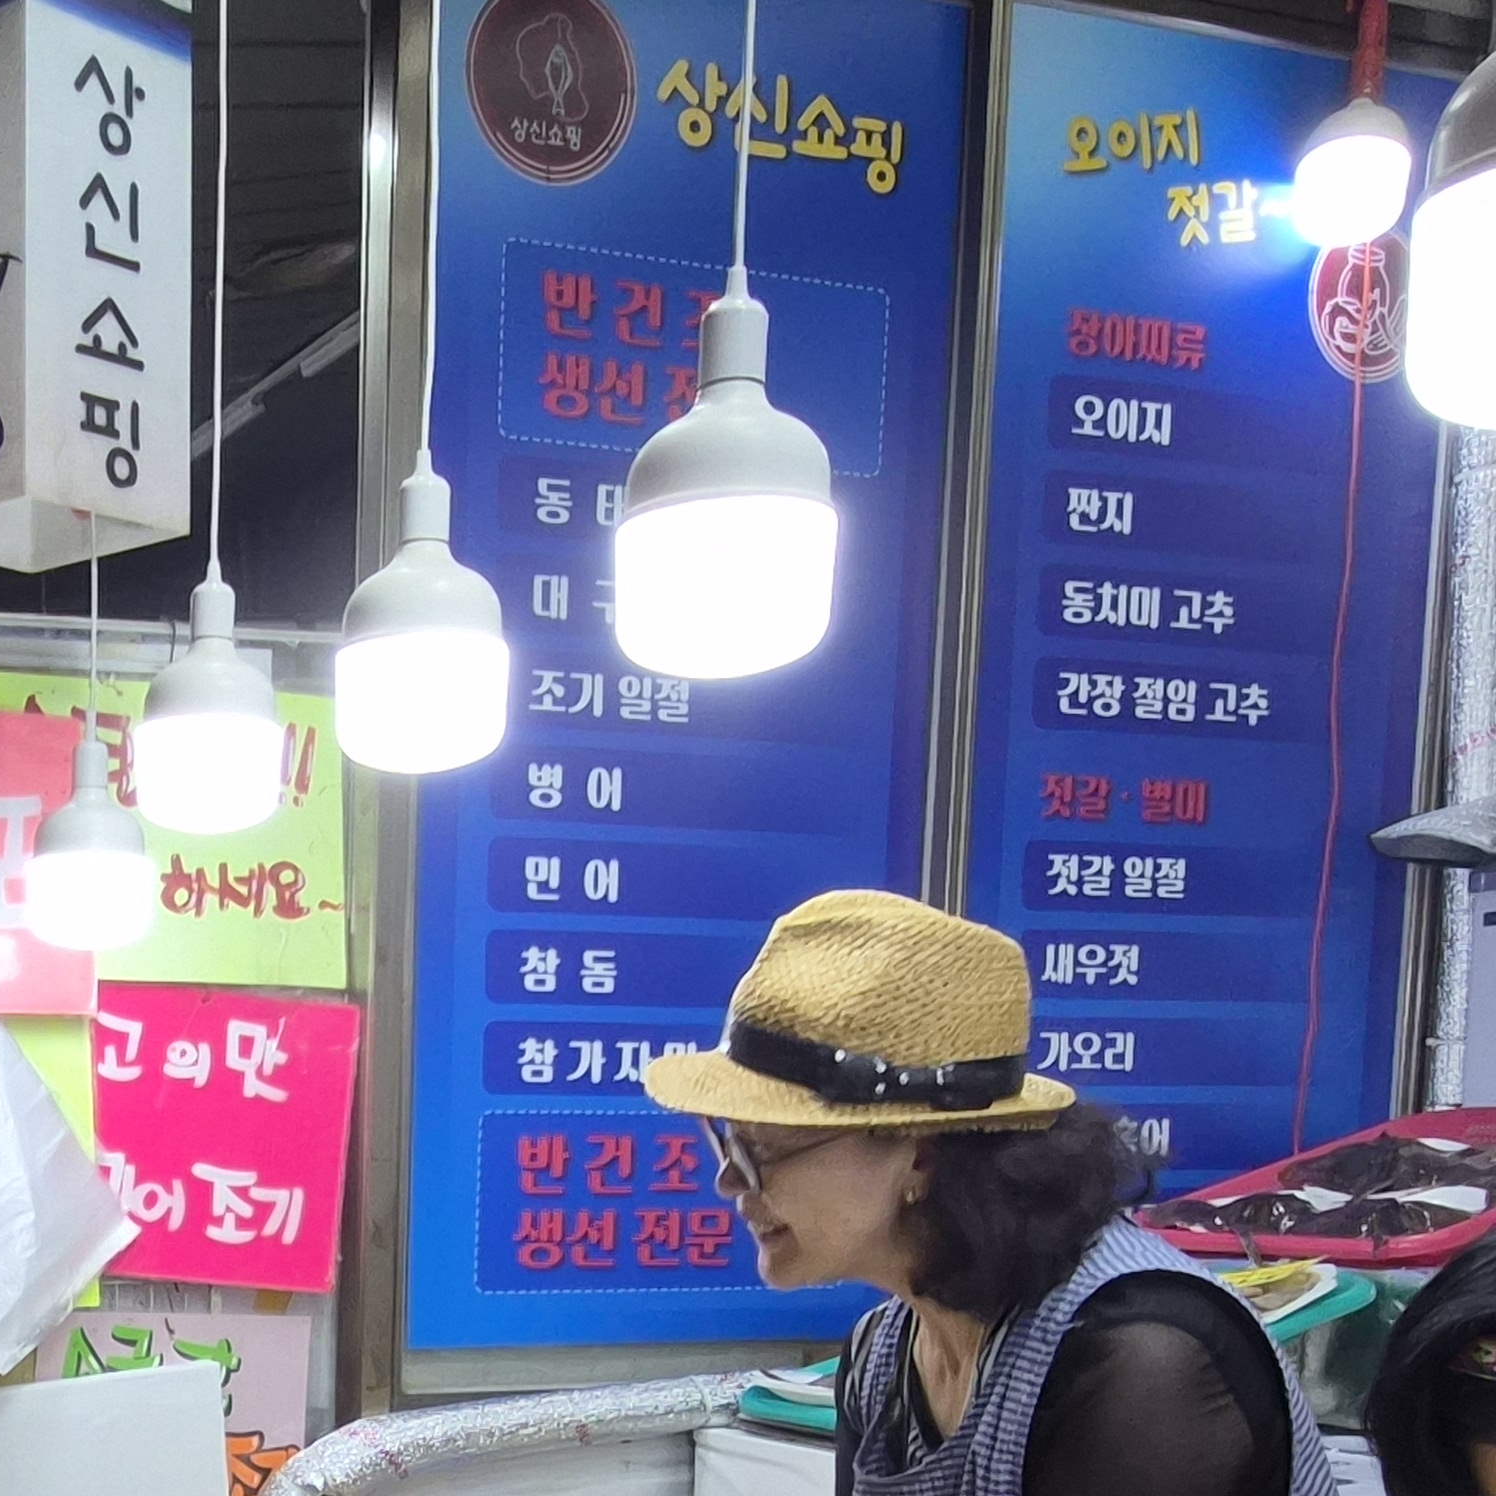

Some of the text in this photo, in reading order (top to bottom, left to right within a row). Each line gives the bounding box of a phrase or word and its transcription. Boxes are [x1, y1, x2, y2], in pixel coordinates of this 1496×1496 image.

[510, 116, 584, 151] 상신쇼핑
[657, 58, 904, 195] 상신쇼핑
[1062, 106, 1200, 173] 오이지
[1167, 179, 1259, 248] 젓갈
[1066, 307, 1208, 371] 장아찌류
[538, 351, 646, 426] 생선
[1071, 394, 1173, 446] 오이지
[1066, 487, 1134, 536] 짠지
[1061, 580, 1236, 634] 동치미 고추
[528, 669, 690, 723] 조기 일절
[1057, 672, 1271, 727] 간장 절임 고추
[1040, 772, 1209, 825] 젓갈 별미
[1045, 854, 1188, 899] 젓갈 일절
[1041, 943, 1140, 985] 새우젓
[1036, 1031, 1136, 1072] 가오리
[191, 1161, 305, 1245] 조기
[513, 1208, 734, 1270] 생선 전문
